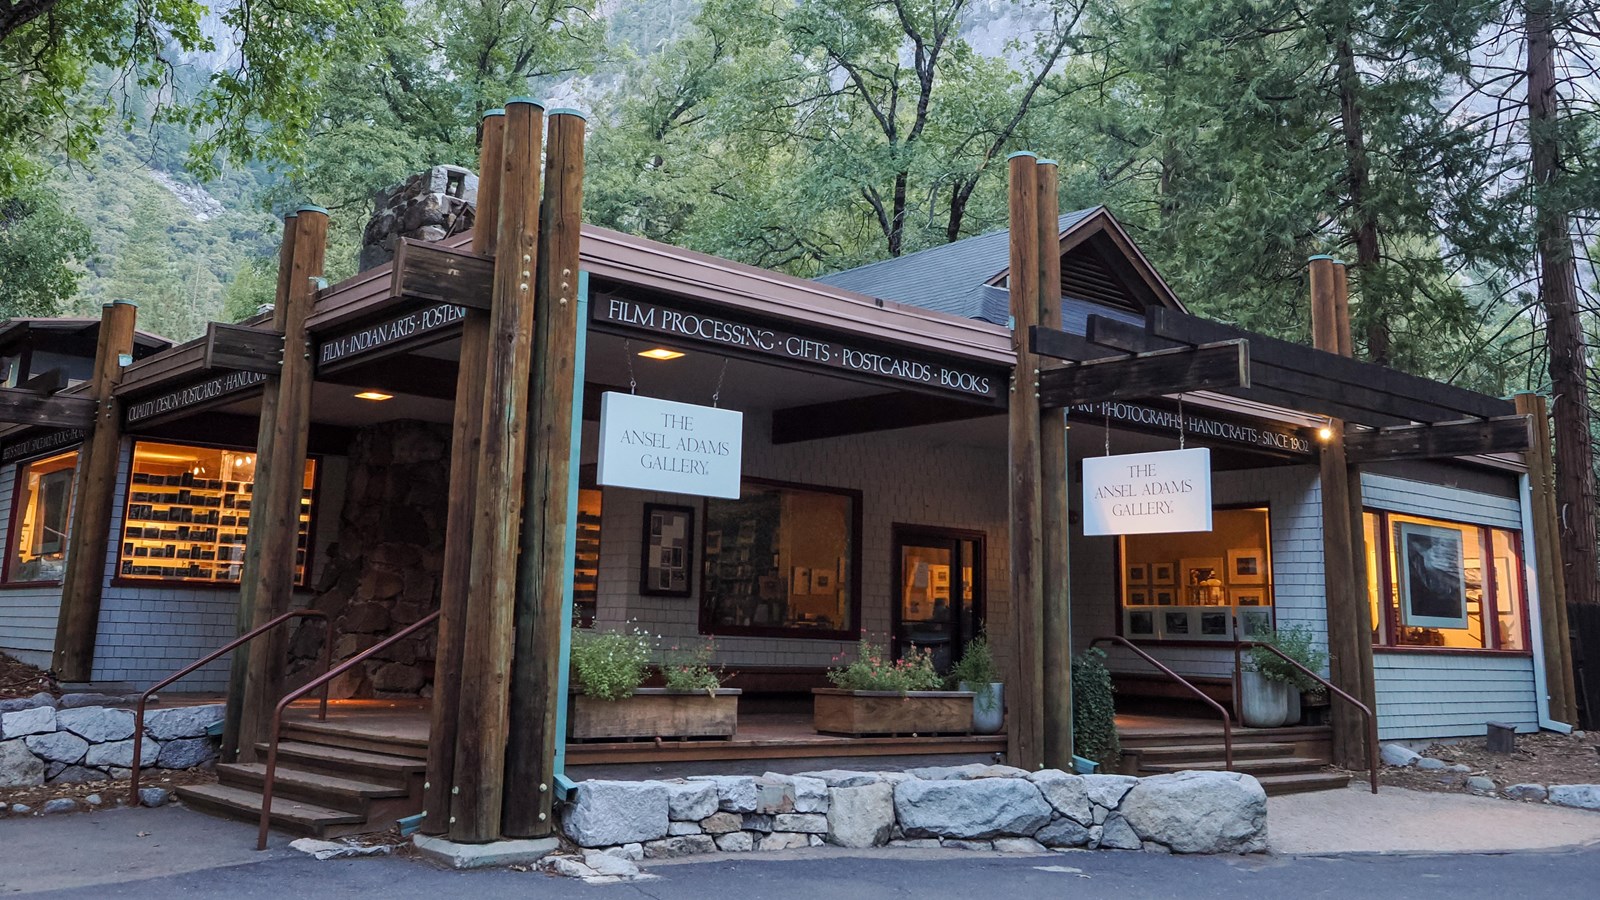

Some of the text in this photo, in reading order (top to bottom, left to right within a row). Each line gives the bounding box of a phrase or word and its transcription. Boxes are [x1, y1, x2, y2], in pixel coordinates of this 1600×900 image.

[322, 338, 346, 363] FILM
[349, 324, 388, 353] INDIAN
[387, 314, 417, 341] ARTS
[608, 299, 990, 394] FILM PROCESSING GIFTS POSTCARDS BOOKS
[128, 400, 156, 422] QUALITY
[155, 393, 179, 413] DESIGN
[181, 378, 222, 406] POSTCARDS
[660, 412, 694, 432] THE
[1101, 401, 1182, 429] PHOTOGRAPHS
[1188, 417, 1258, 443] HANDCRAFTS
[1262, 430, 1289, 449] SINCE
[1289, 437, 1310, 452] 1902
[620, 429, 730, 457] ANSEL ADAMS
[1127, 463, 1157, 478] THE
[1094, 479, 1193, 499] ANSEL ADAMS
